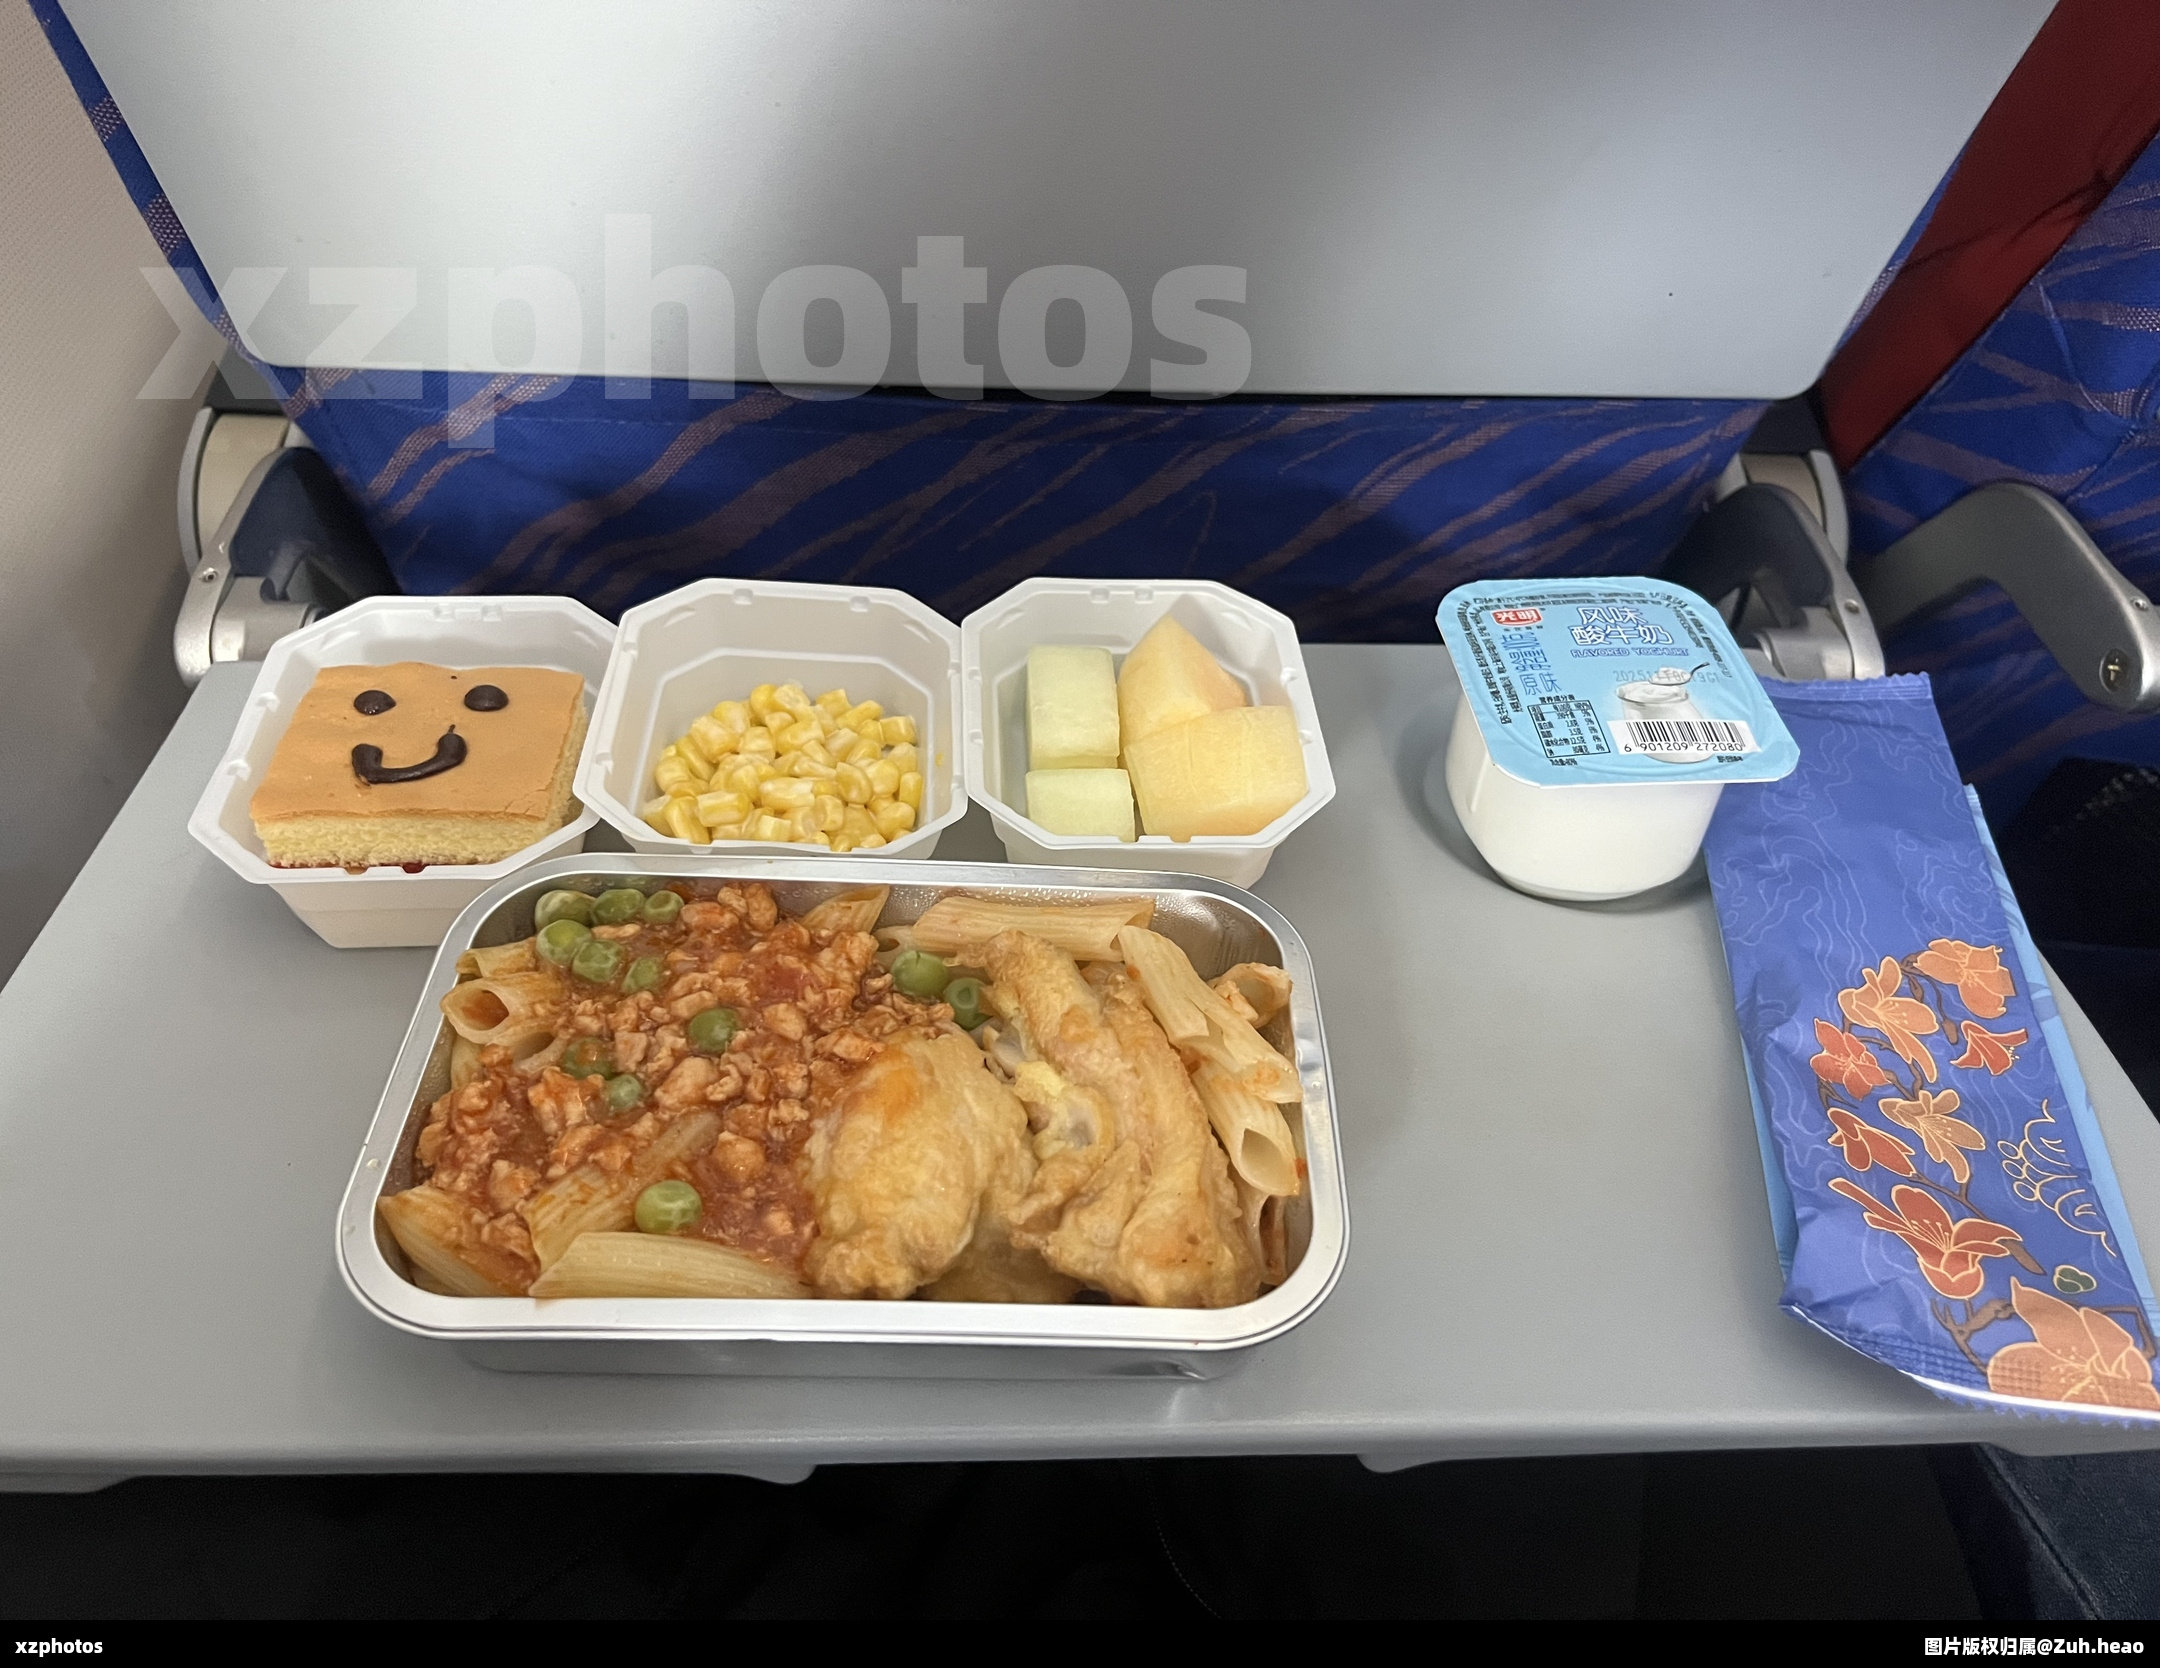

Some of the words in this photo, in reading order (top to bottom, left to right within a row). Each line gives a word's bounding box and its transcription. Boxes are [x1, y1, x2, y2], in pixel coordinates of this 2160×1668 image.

[1496, 609, 1539, 622] 光明
[1577, 606, 1648, 625] 风味
[1569, 624, 1675, 646] 酸牛奶
[1571, 648, 1630, 658] FLAVORED
[1631, 647, 1690, 657] YOGHURT
[1519, 671, 1562, 696] 原味
[1624, 743, 1632, 752] 6
[1640, 743, 1688, 751] 901209
[1695, 743, 1744, 752] 272080
